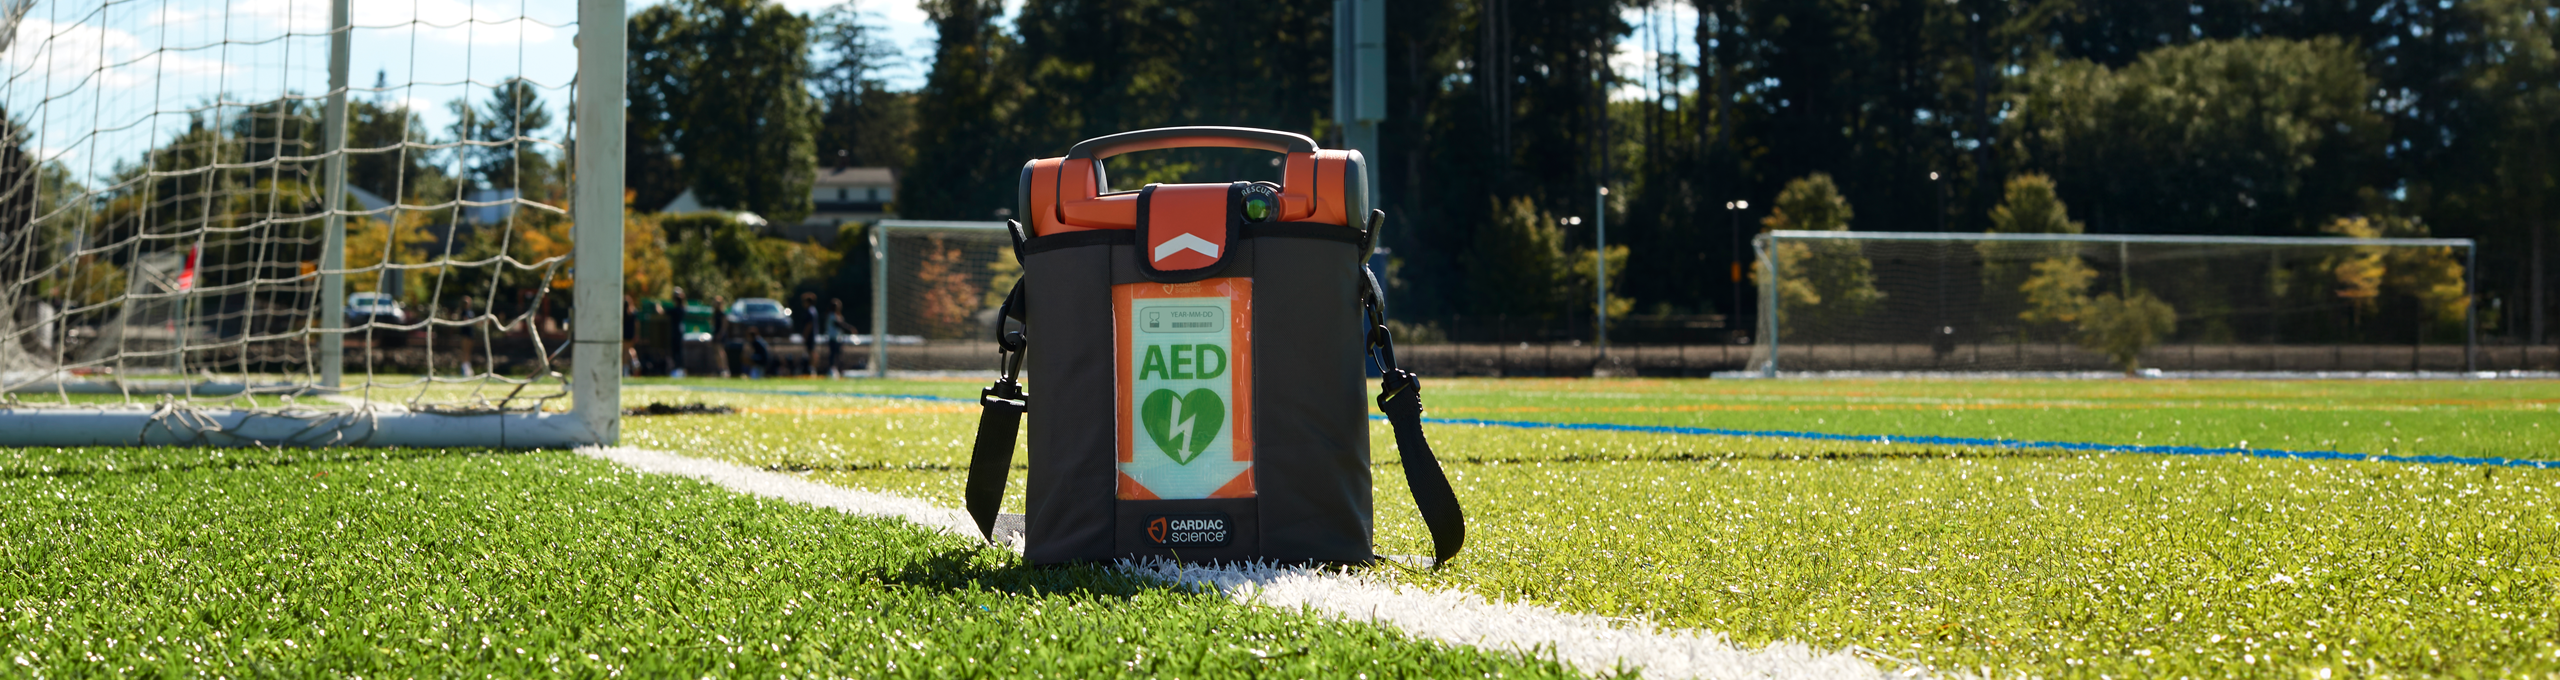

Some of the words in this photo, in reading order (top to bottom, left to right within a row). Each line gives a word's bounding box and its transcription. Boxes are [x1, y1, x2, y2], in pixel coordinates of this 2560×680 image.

[1241, 186, 1271, 196] RESCUE
[1139, 345, 1227, 380] AED
[1171, 519, 1223, 530] CARDIAC
